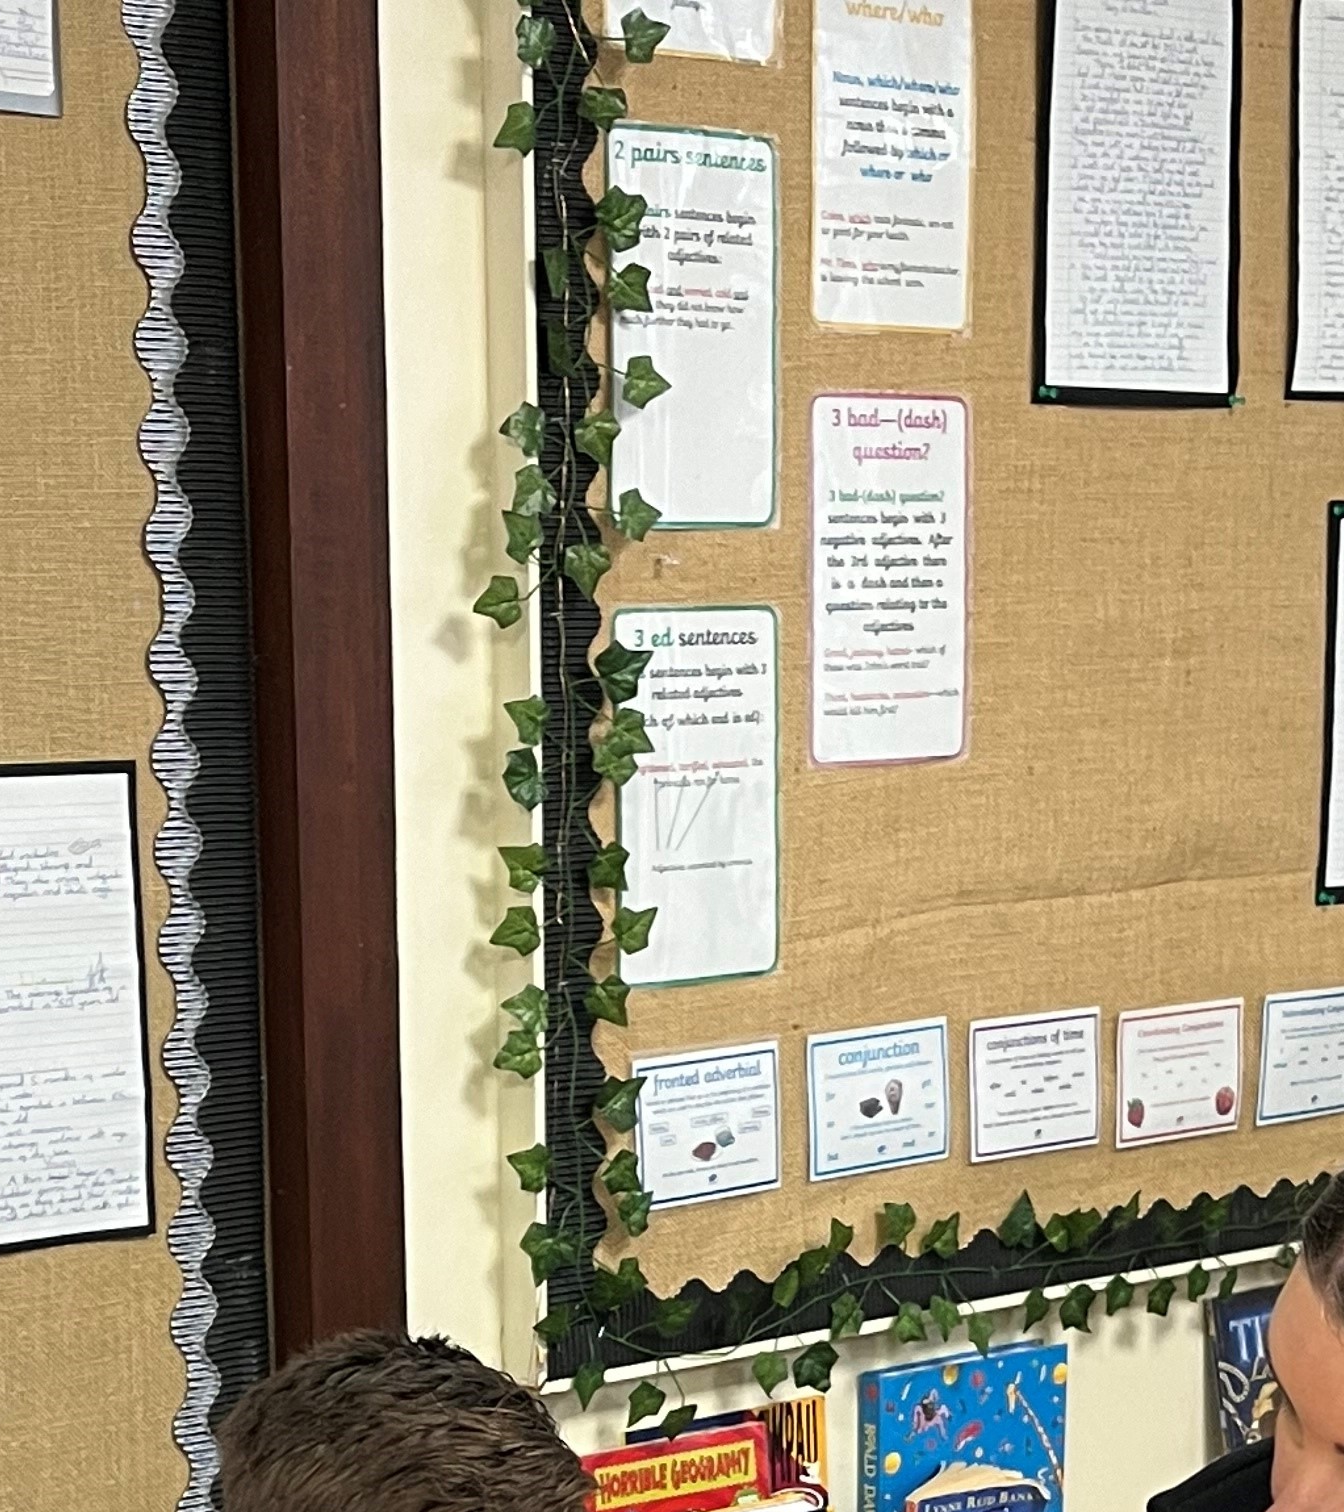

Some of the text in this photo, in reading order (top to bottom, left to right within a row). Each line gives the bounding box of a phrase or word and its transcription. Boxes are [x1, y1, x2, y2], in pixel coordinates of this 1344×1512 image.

[615, 139, 768, 172] 2 pairs sentences
[644, 203, 757, 229] airs sentences begin
[832, 408, 842, 427] 3
[853, 441, 931, 466] question?
[829, 489, 836, 502] 3
[899, 490, 945, 506] question?
[828, 514, 879, 524] sentences
[881, 511, 909, 527] begin
[913, 511, 936, 524] with
[890, 577, 909, 588] and
[634, 627, 760, 648] 3 ed sentences
[650, 667, 704, 679] sentences
[706, 664, 734, 680] begin
[838, 1038, 920, 1068] conjunction
[987, 1027, 1085, 1054] conjunctions of time
[653, 1058, 763, 1096] fronted adverbial
[863, 1423, 877, 1478] ROALD
[598, 1446, 752, 1506] HORRIBLE GEOGRAPHY
